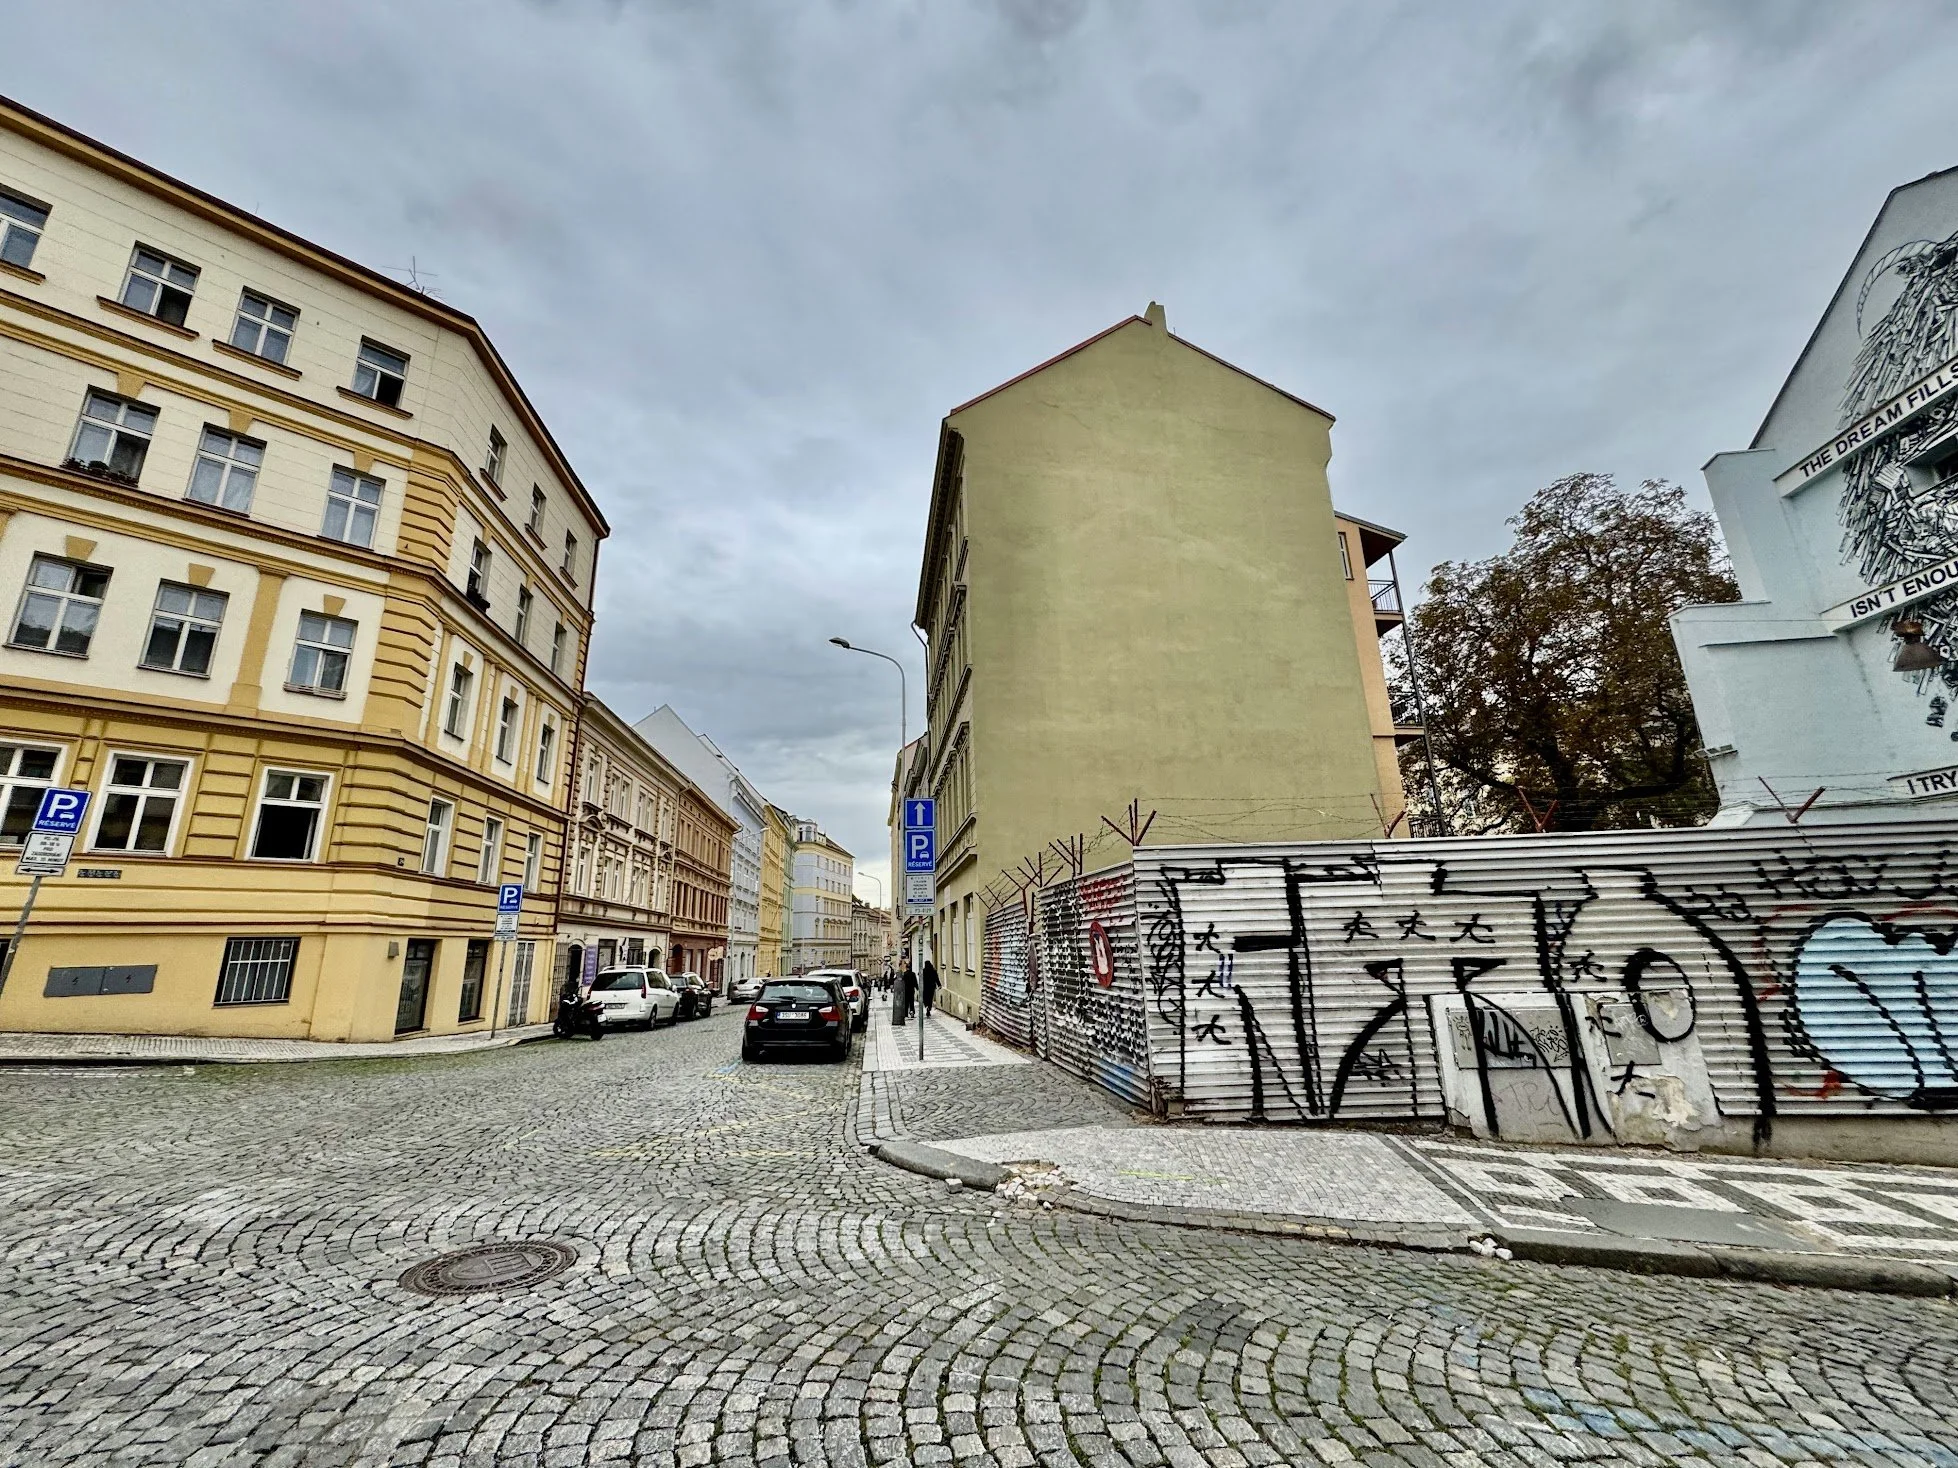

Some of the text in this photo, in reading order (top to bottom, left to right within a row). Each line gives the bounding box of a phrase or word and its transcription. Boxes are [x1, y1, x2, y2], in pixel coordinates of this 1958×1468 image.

[1800, 449, 1833, 477] THE
[1835, 403, 1903, 456] DREAM
[1916, 771, 1957, 792] TRY
[46, 793, 78, 818] P
[911, 834, 929, 859] P
[503, 887, 518, 904] P
